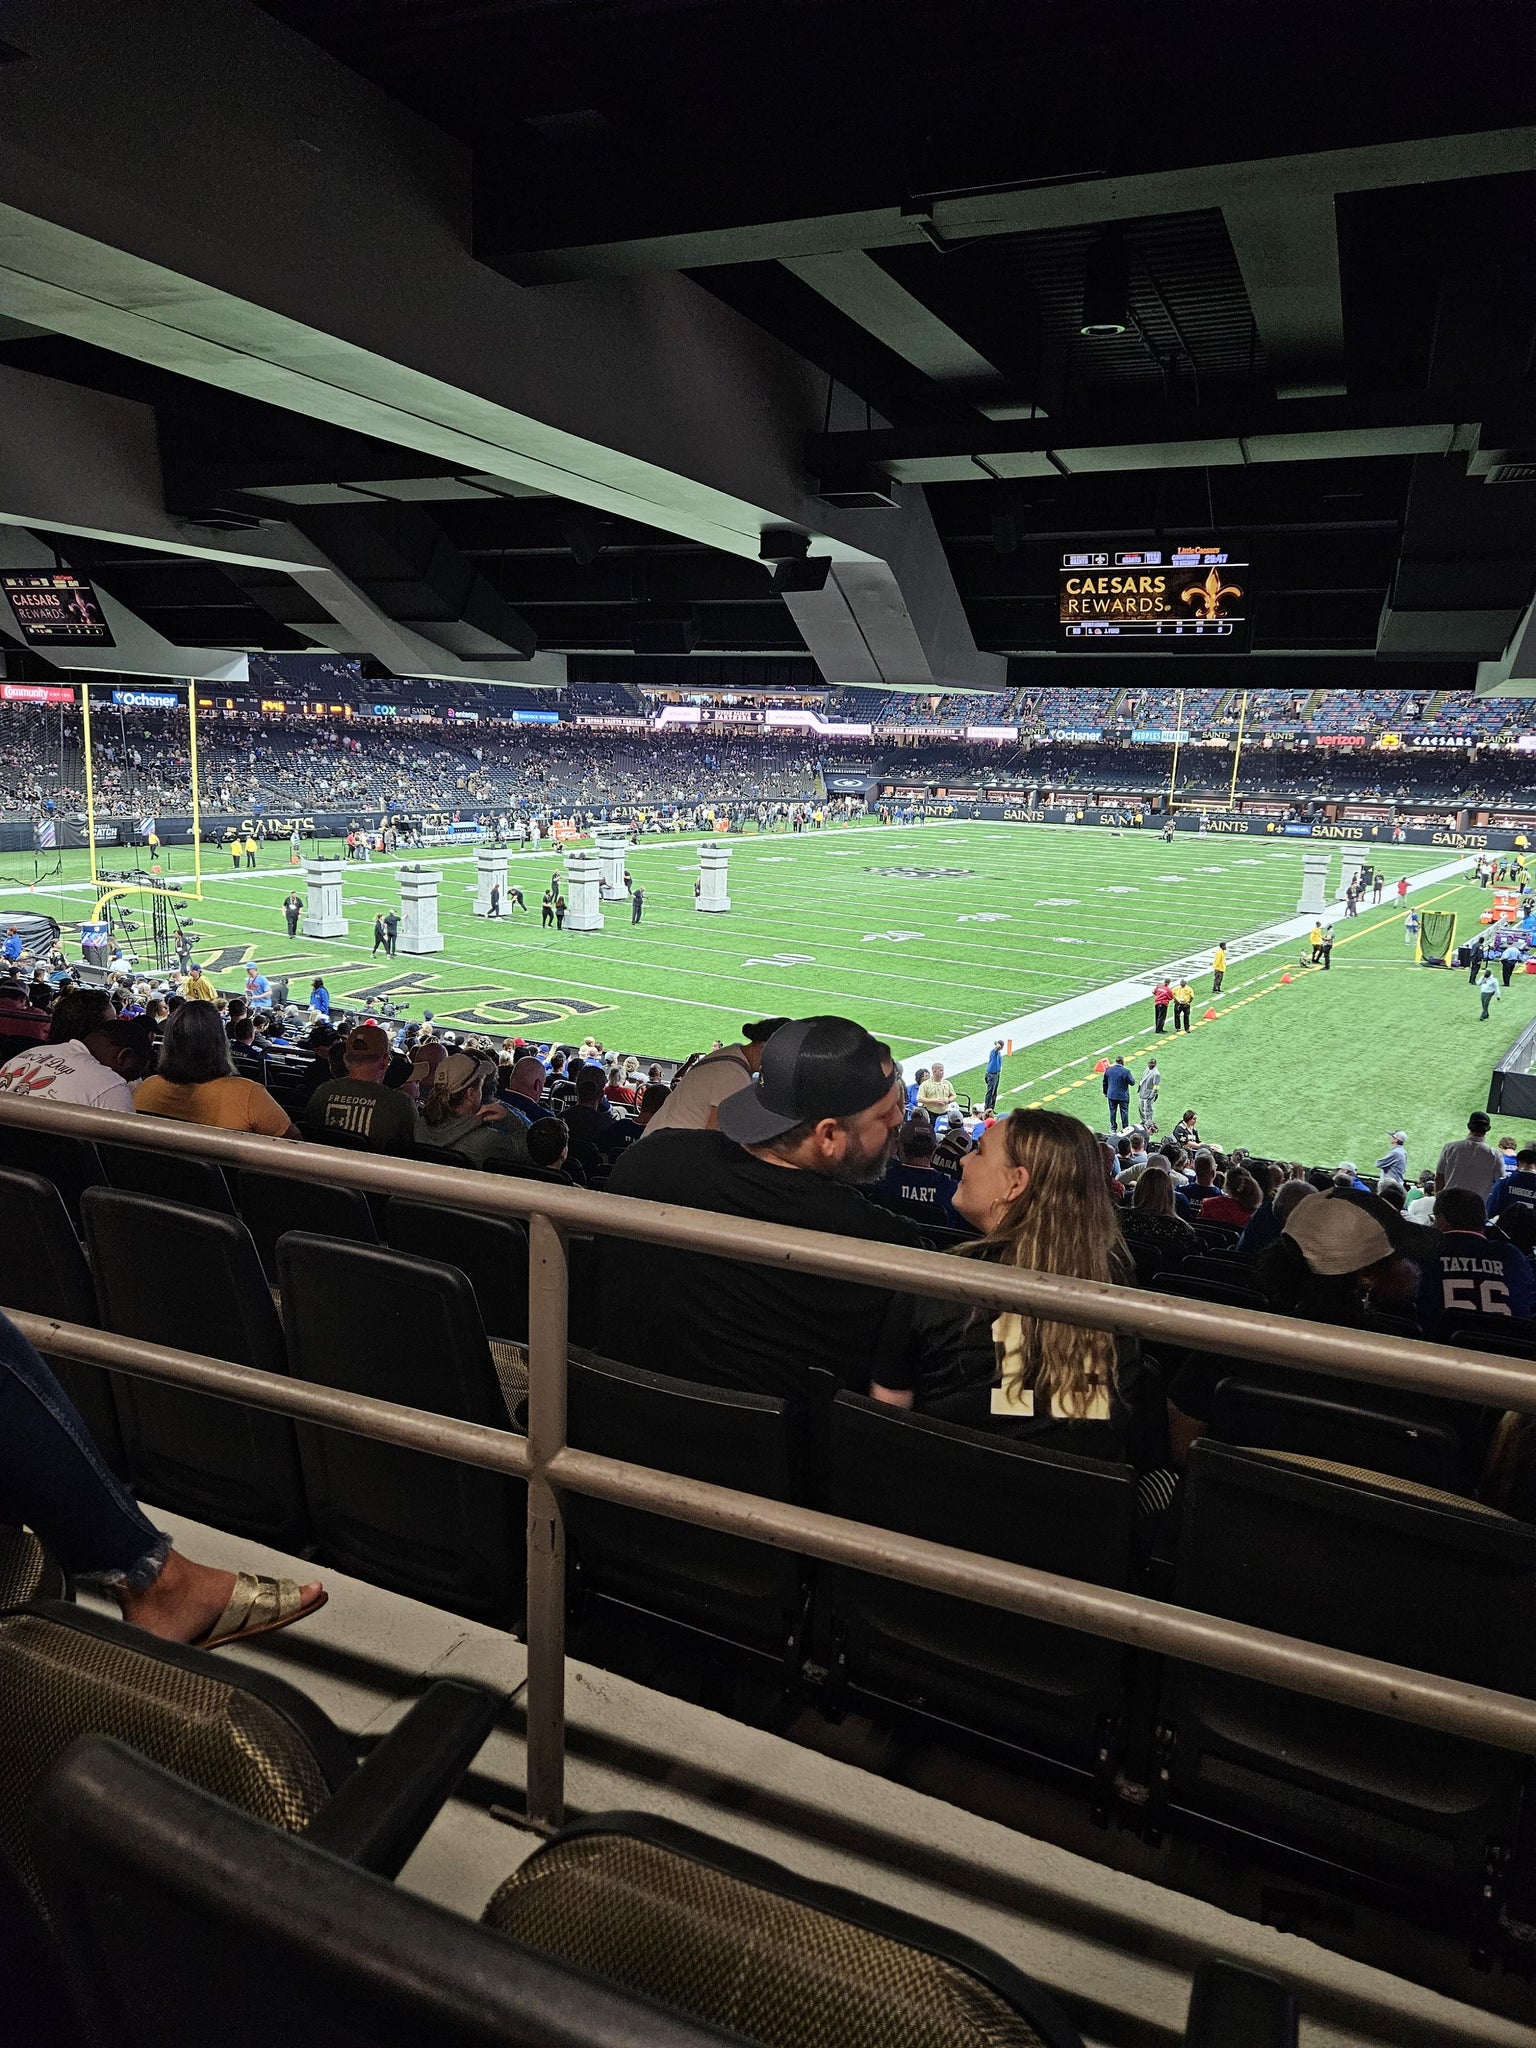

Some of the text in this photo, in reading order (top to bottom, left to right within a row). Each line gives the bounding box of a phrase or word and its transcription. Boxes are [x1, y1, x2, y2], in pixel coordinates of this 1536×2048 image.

[1066, 576, 1166, 595] CAESARS
[12, 594, 60, 606] CAESARS
[1068, 597, 1164, 613] REWARDS
[18, 608, 66, 619] REWARDS
[4, 684, 49, 700] Community
[124, 694, 176, 707] Ochsner
[373, 704, 397, 716] COX
[411, 706, 436, 716] SAINTS
[455, 709, 479, 720] entergy
[1020, 727, 1046, 736] SAINTS
[1056, 729, 1102, 741] Ochsner
[1132, 731, 1161, 741] PEOPLES
[1202, 731, 1231, 739] SAINTS
[1264, 732, 1295, 740] SAINTS
[1315, 733, 1366, 746] verizon
[1413, 736, 1473, 747] CAESARS
[1416, 800, 1536, 811] SUPERDO
[1003, 809, 1045, 822] SAINTS
[241, 816, 316, 834] SAINTS
[93, 828, 118, 837] CATCH
[1311, 825, 1364, 839] SAINTS
[1431, 832, 1488, 847] SAINTS
[328, 1094, 378, 1107] FREEDOM
[1440, 1256, 1504, 1276] TAYLOR
